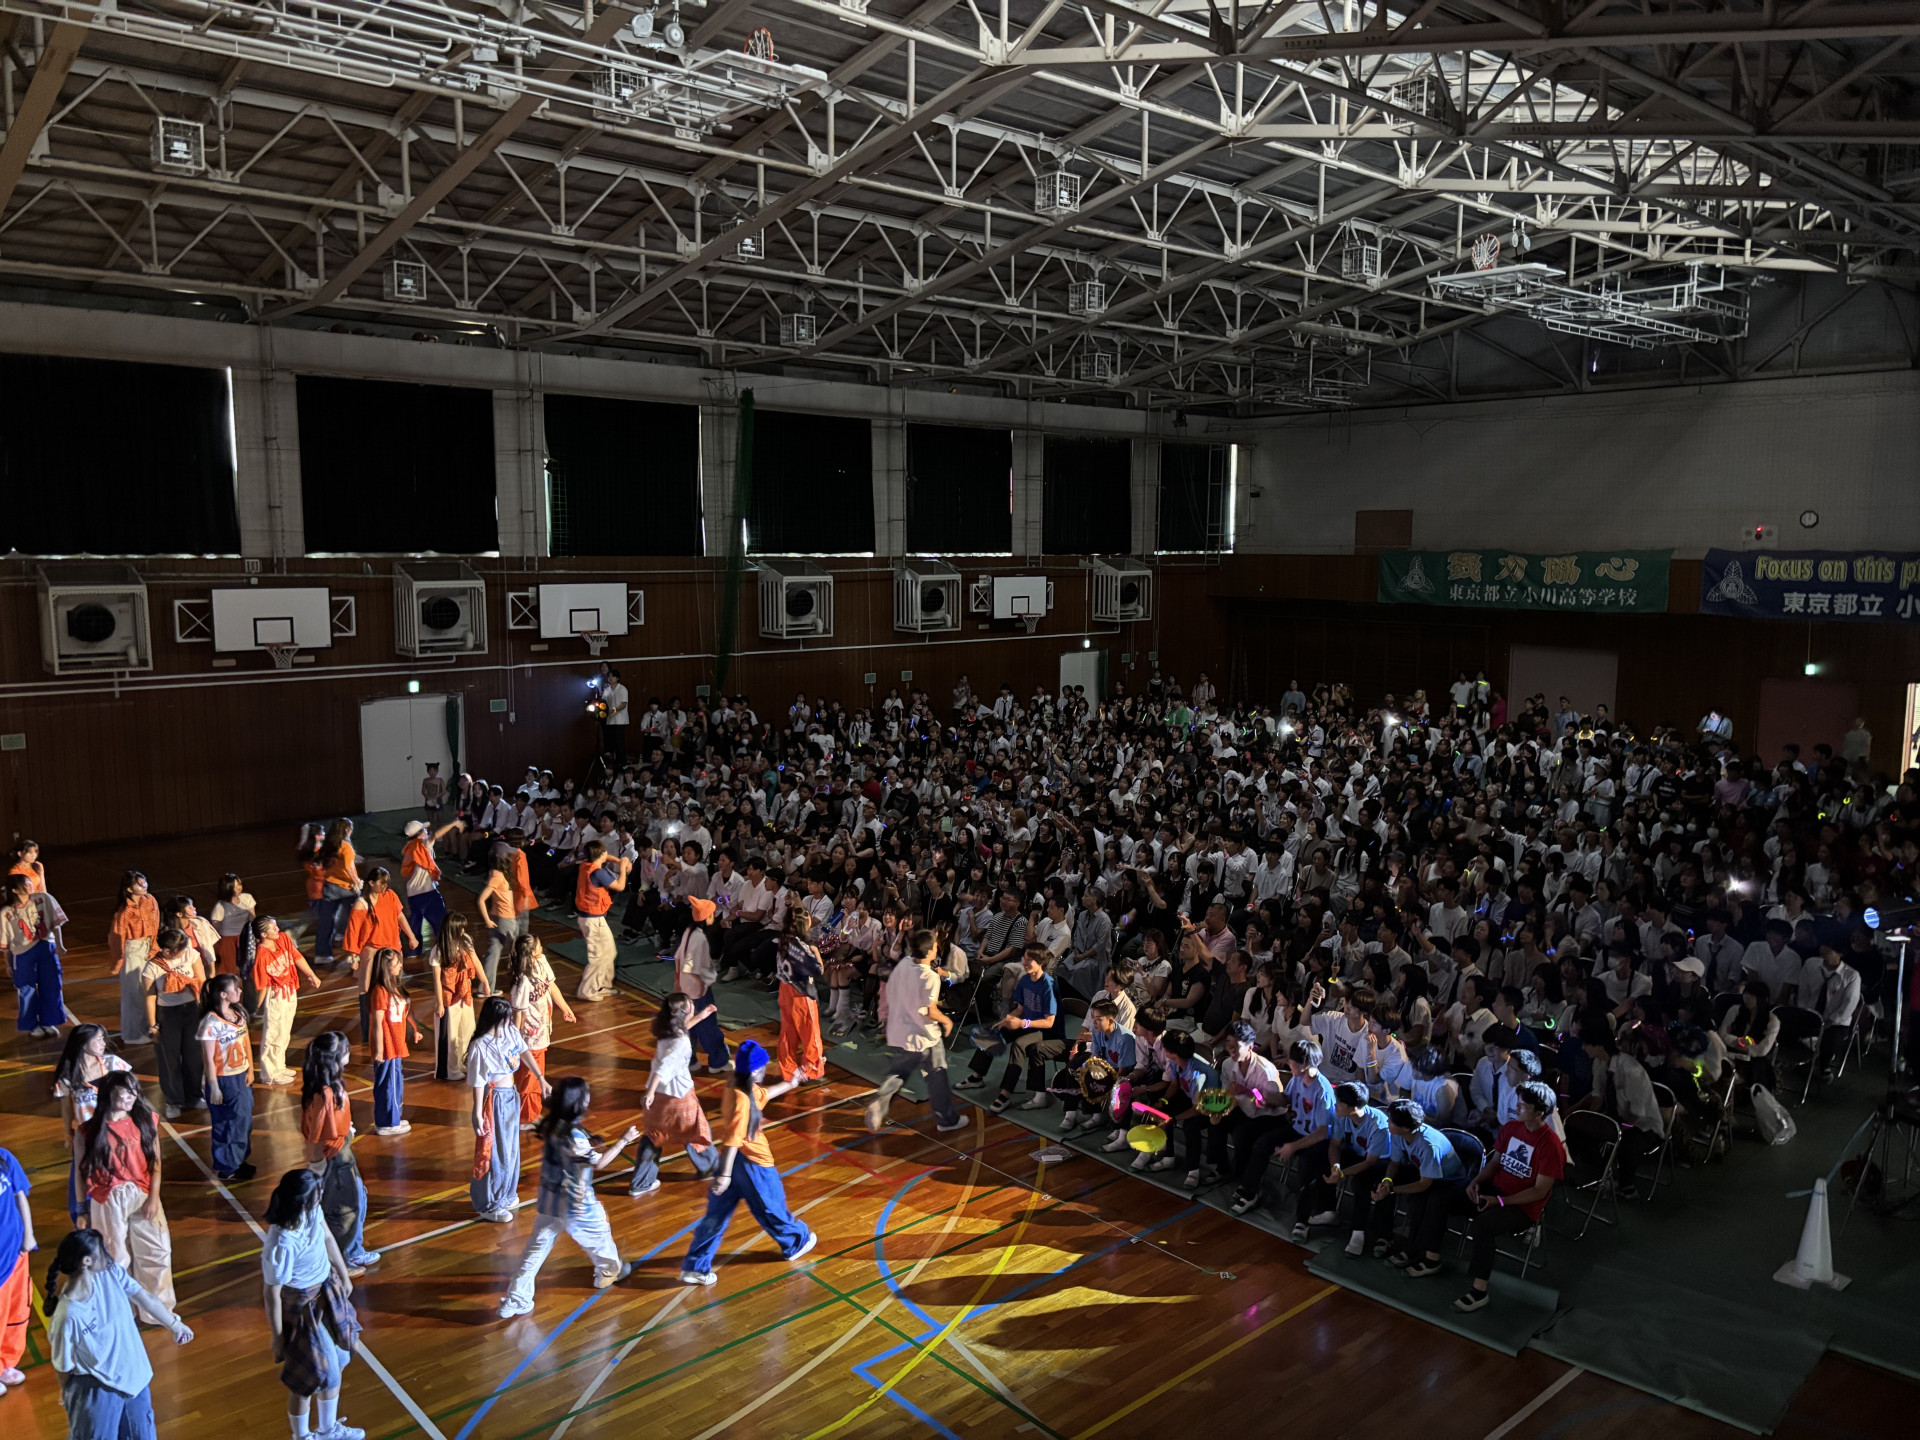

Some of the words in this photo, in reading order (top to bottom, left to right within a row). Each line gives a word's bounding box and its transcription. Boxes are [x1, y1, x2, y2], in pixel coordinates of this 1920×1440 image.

[1755, 555, 1814, 582] Focus
[1818, 559, 1848, 583] on
[1854, 555, 1896, 584] this
[1782, 592, 1885, 617] 東京都立
